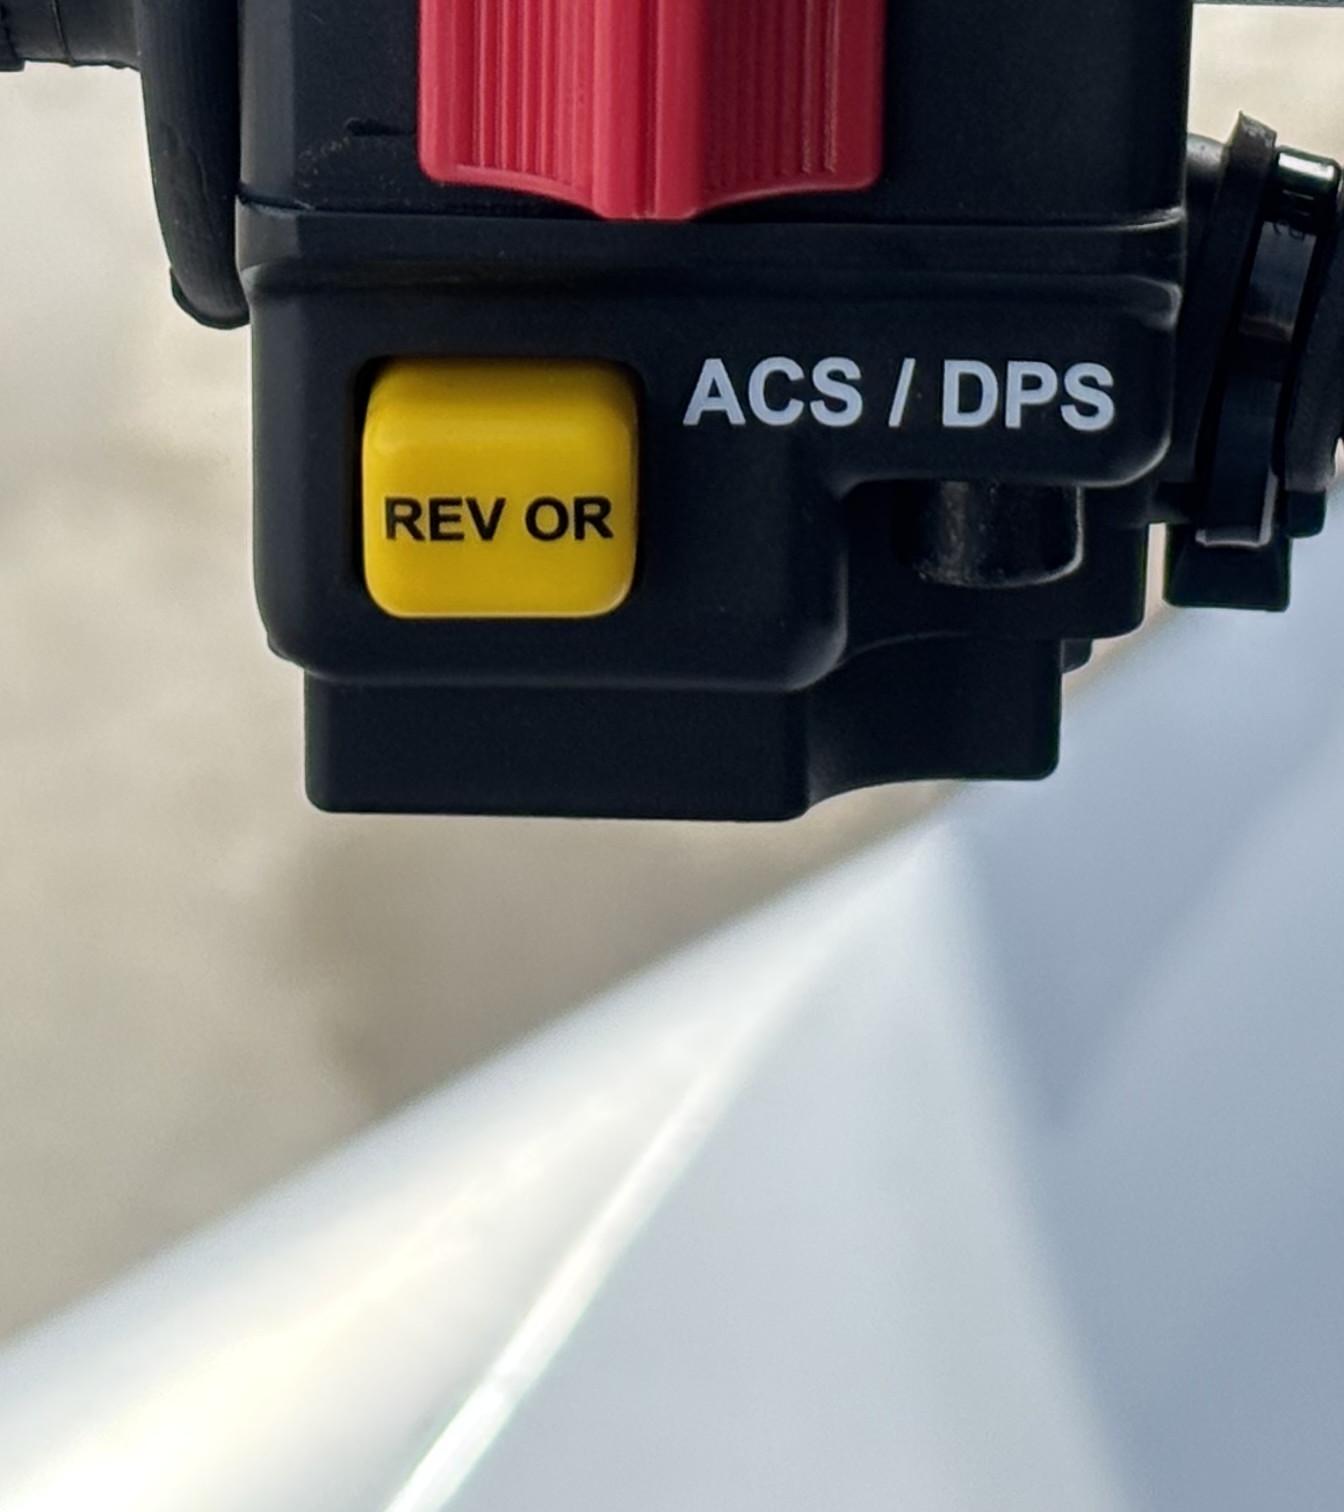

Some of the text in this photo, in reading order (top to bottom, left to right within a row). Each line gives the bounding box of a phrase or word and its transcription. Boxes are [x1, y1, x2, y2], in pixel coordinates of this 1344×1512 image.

[682, 356, 1116, 433] ACS / DPS
[384, 495, 615, 543] REV OR
